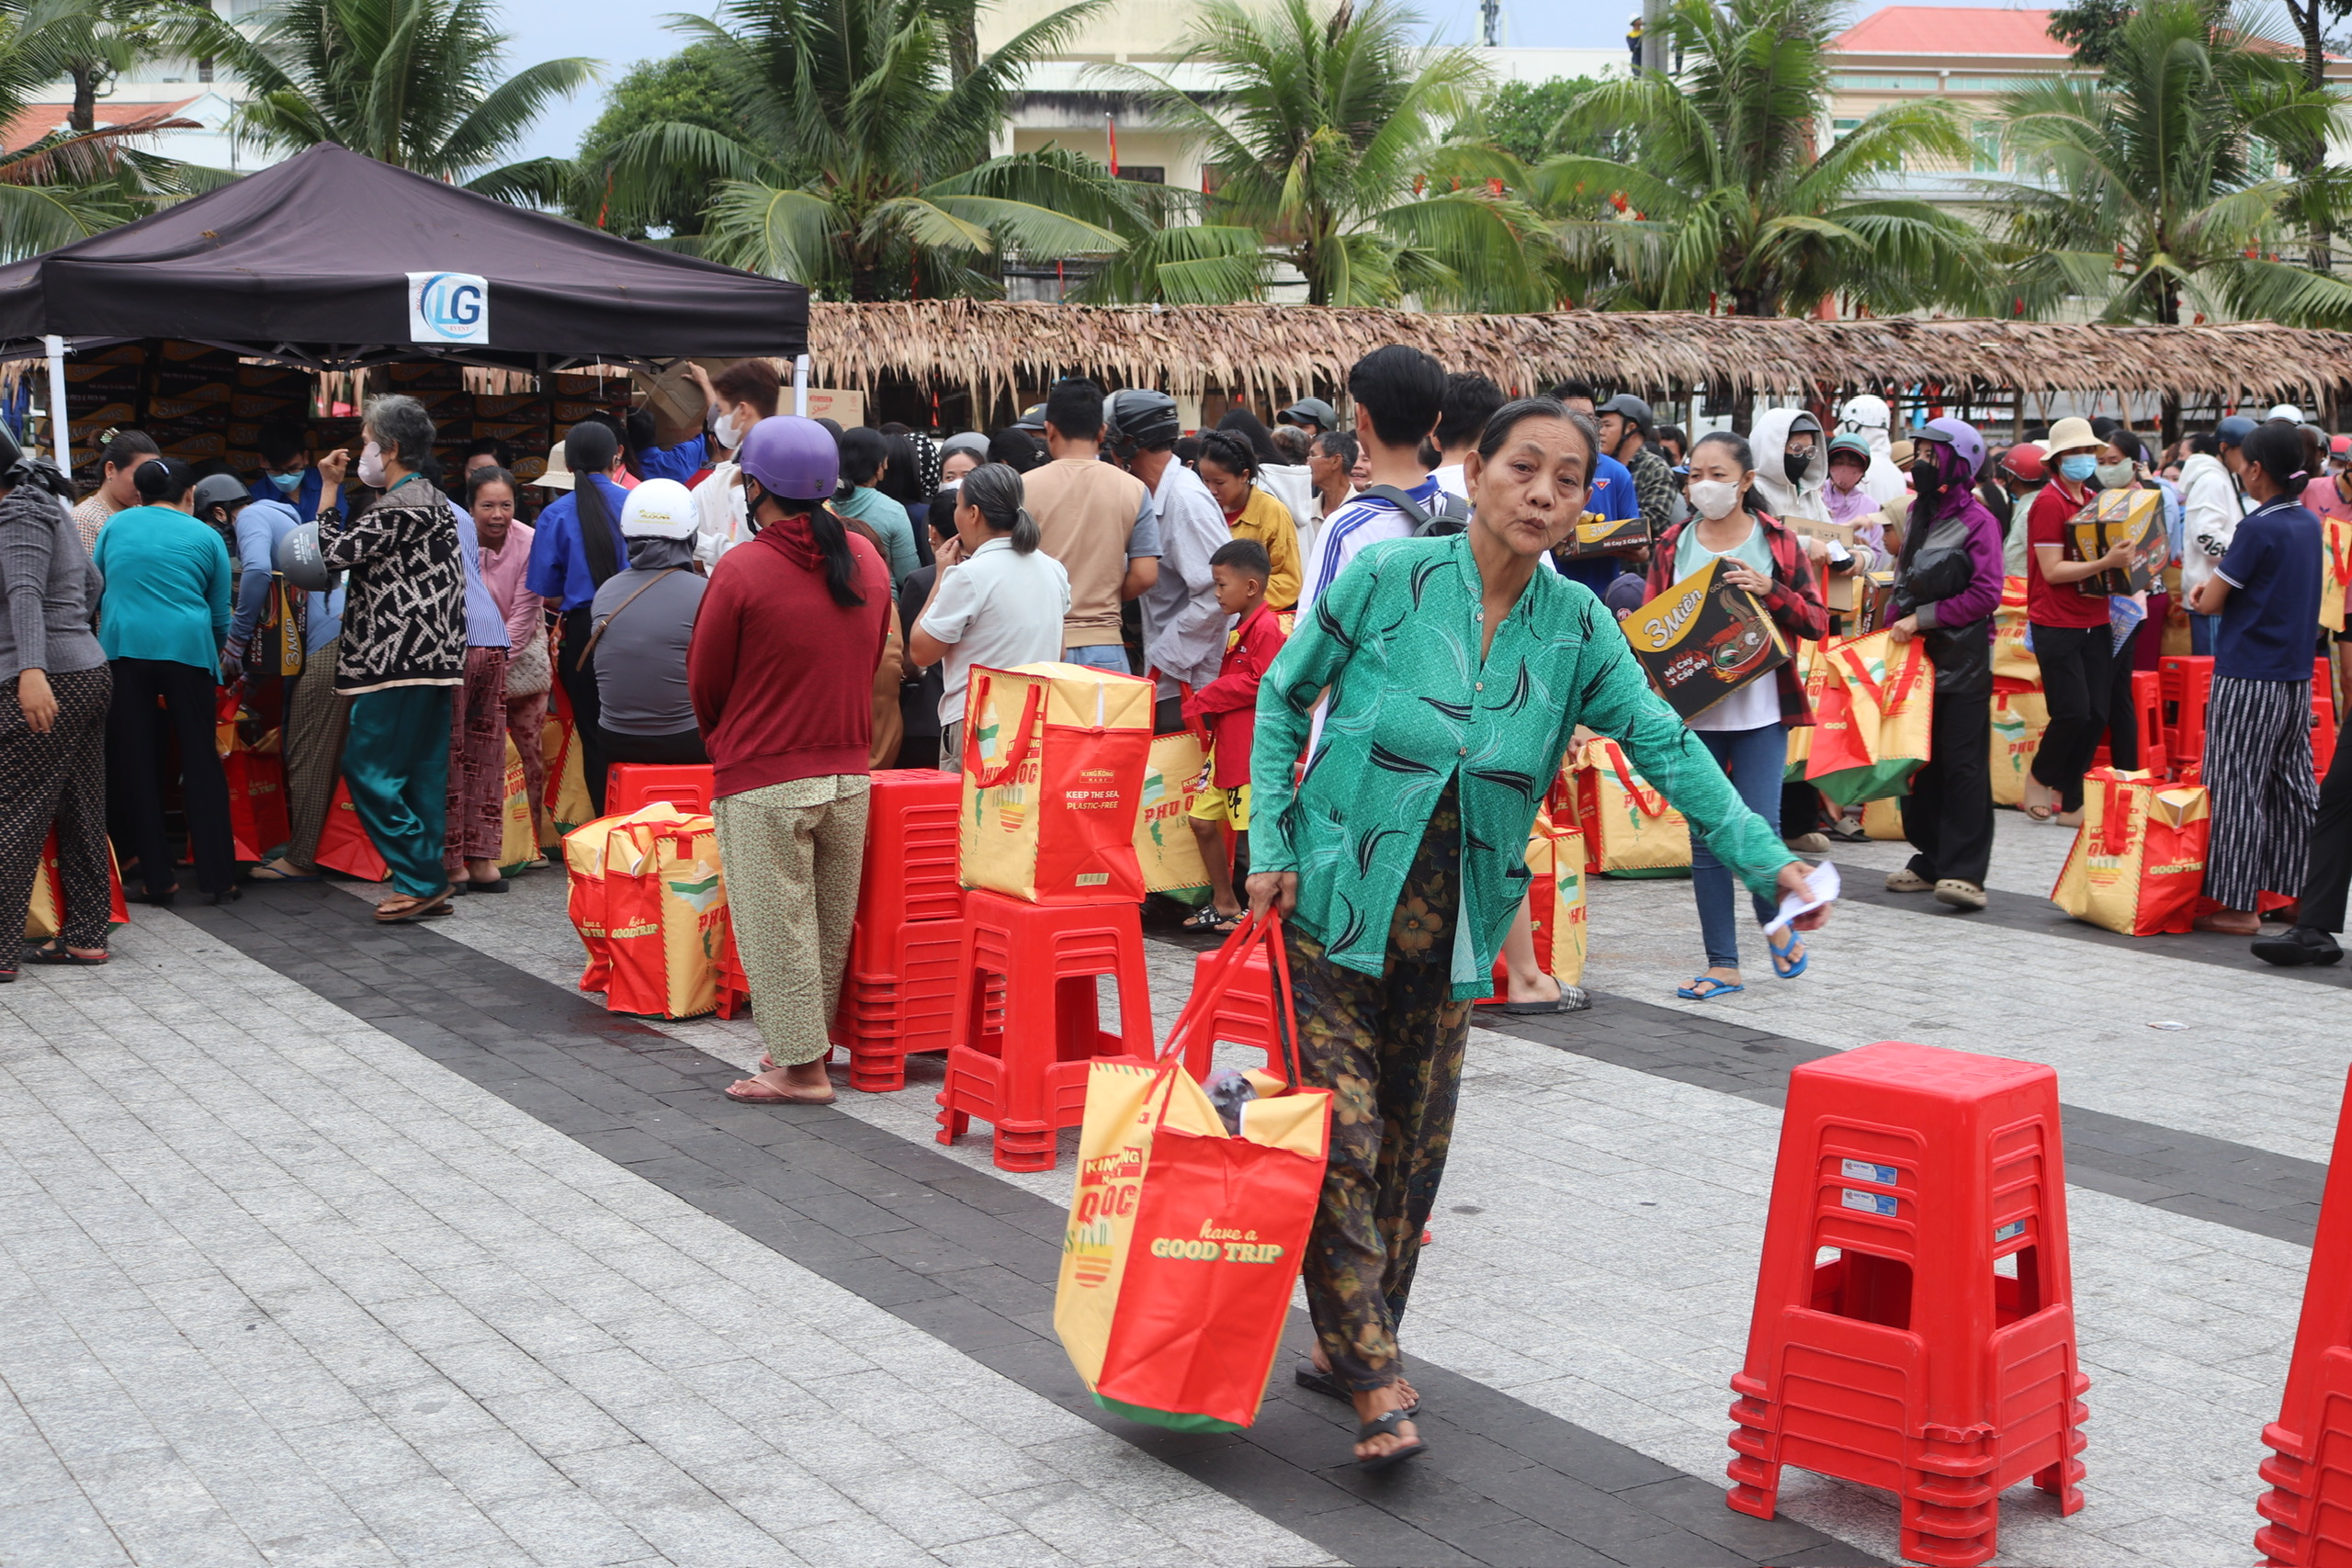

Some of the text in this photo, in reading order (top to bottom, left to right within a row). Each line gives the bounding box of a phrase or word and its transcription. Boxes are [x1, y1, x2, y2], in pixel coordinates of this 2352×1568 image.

[1670, 659, 1709, 686] 3 Cấp Độ
[1677, 656, 1694, 671] Cay
[1066, 790, 1090, 799] KEEP
[1091, 790, 1104, 799] THE
[1066, 801, 1119, 810] PLASTIC-FREE
[1144, 800, 1181, 824] PHU
[2149, 864, 2183, 874] GOOD
[1199, 1218, 1259, 1241] have a
[1150, 1236, 1285, 1264] GOOD TRIP
